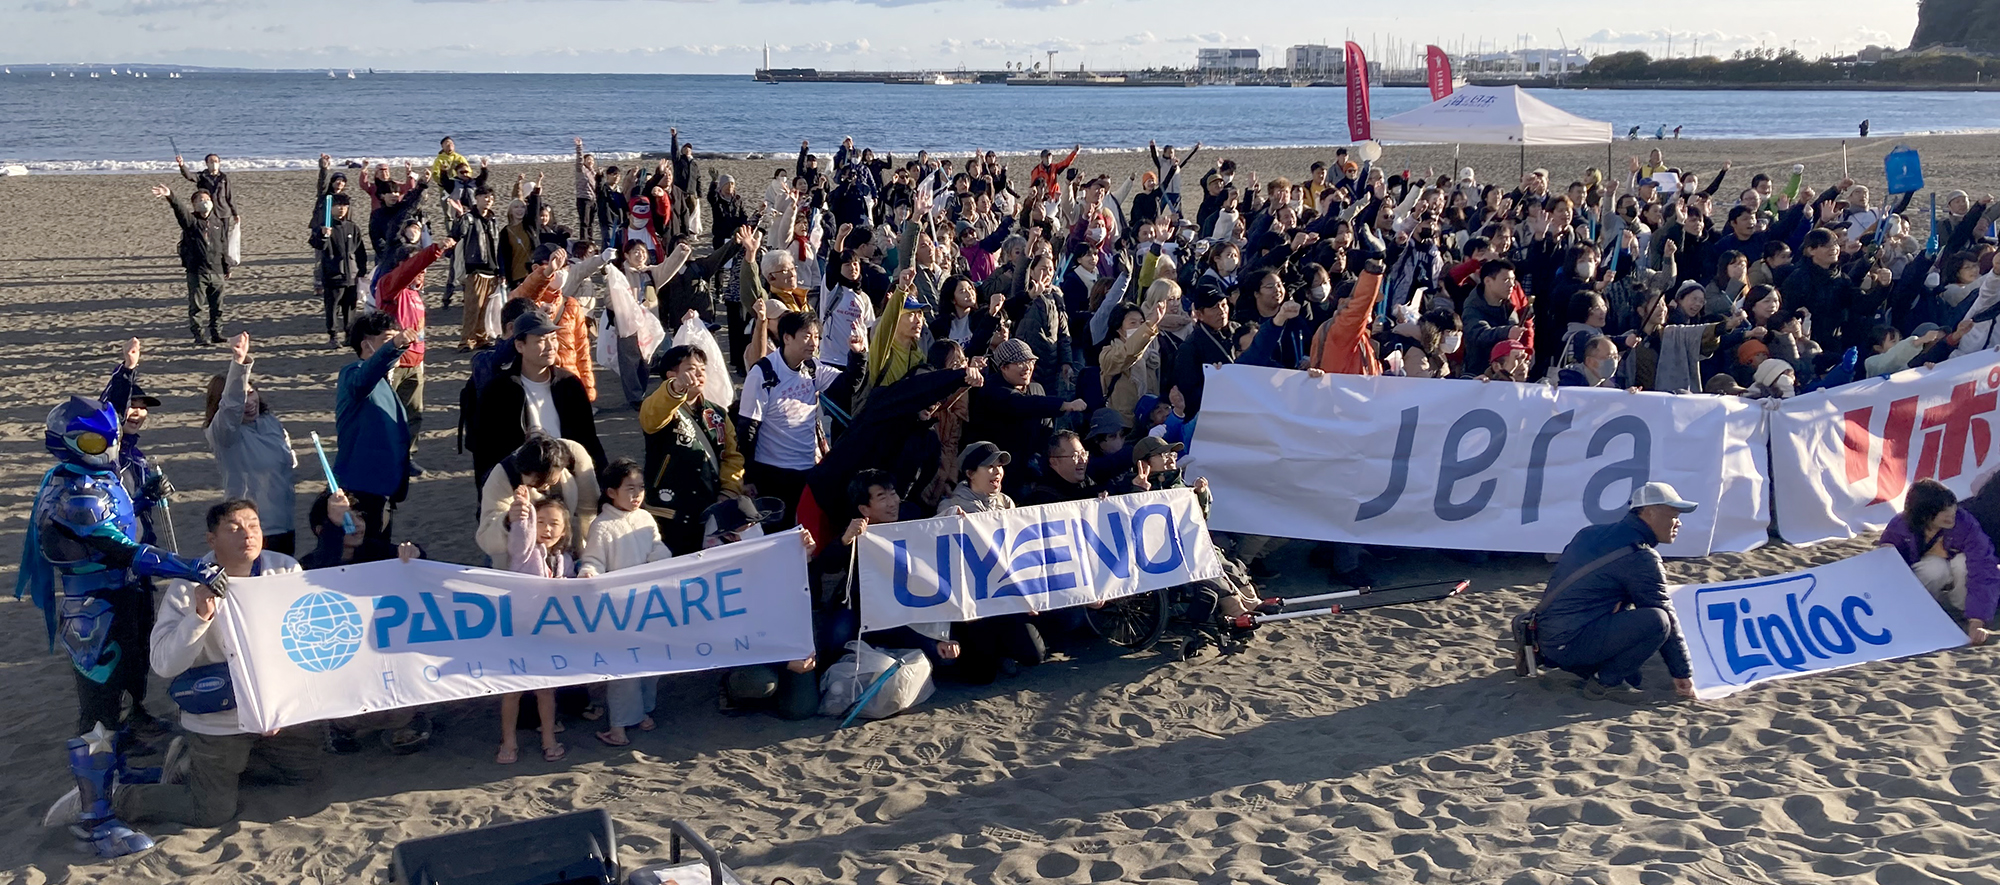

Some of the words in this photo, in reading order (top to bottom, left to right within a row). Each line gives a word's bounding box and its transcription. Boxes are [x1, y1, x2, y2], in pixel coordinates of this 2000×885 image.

[893, 503, 1185, 608] UYENO
[371, 591, 513, 649] PADI
[531, 567, 747, 635] AWARE
[1707, 592, 1893, 675] Ziploc
[382, 635, 750, 690] FOUNDATION
